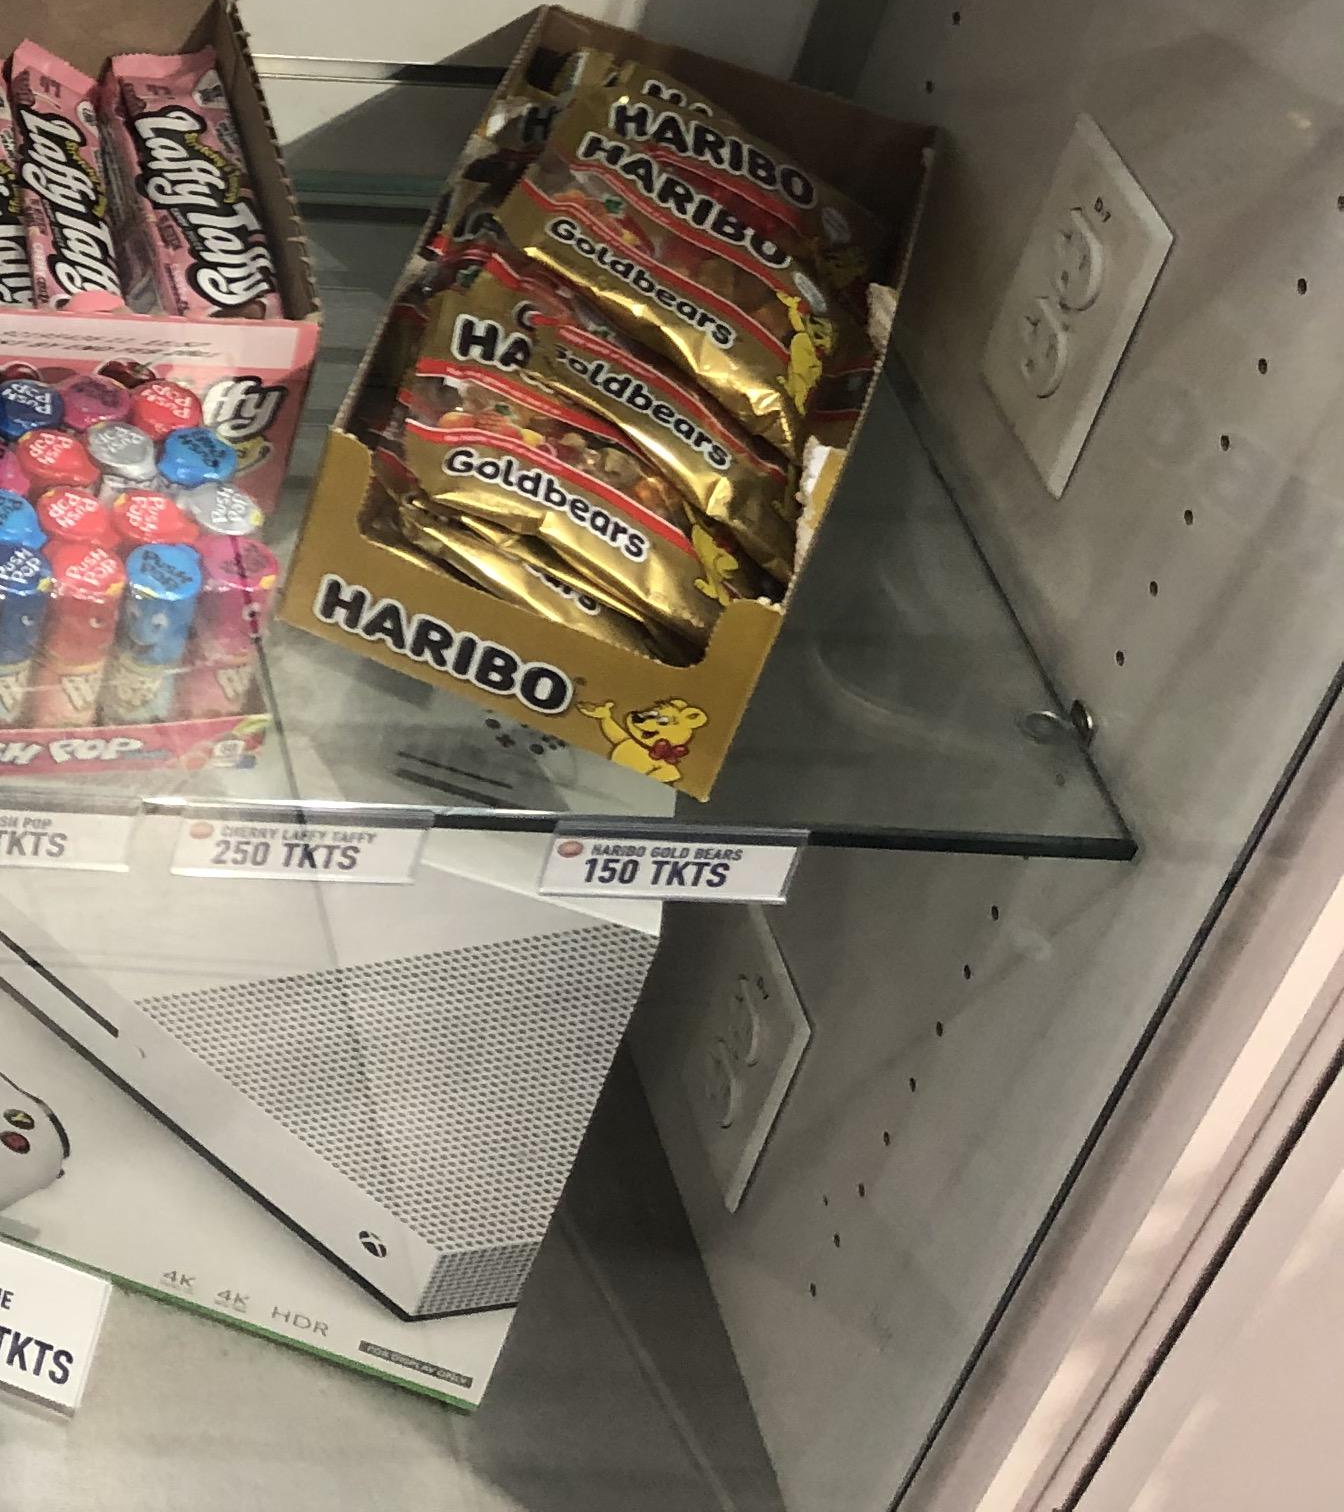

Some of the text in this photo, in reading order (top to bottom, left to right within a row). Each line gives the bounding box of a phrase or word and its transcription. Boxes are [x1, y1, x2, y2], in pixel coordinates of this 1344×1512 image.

[577, 131, 793, 270] HARIBO
[546, 218, 738, 350] Goldbears
[442, 446, 650, 562] Goldbears
[314, 573, 578, 717] HARIBO
[48, 737, 145, 768] POP
[22, 816, 53, 830] POP
[331, 830, 377, 845] TAFFY
[213, 839, 360, 870] 250 TKTS
[591, 844, 743, 862] HARIBO GOLD BEARS
[582, 856, 731, 889] 150 TKTS
[163, 1270, 197, 1288] 4K
[270, 1305, 330, 1338] HDR
